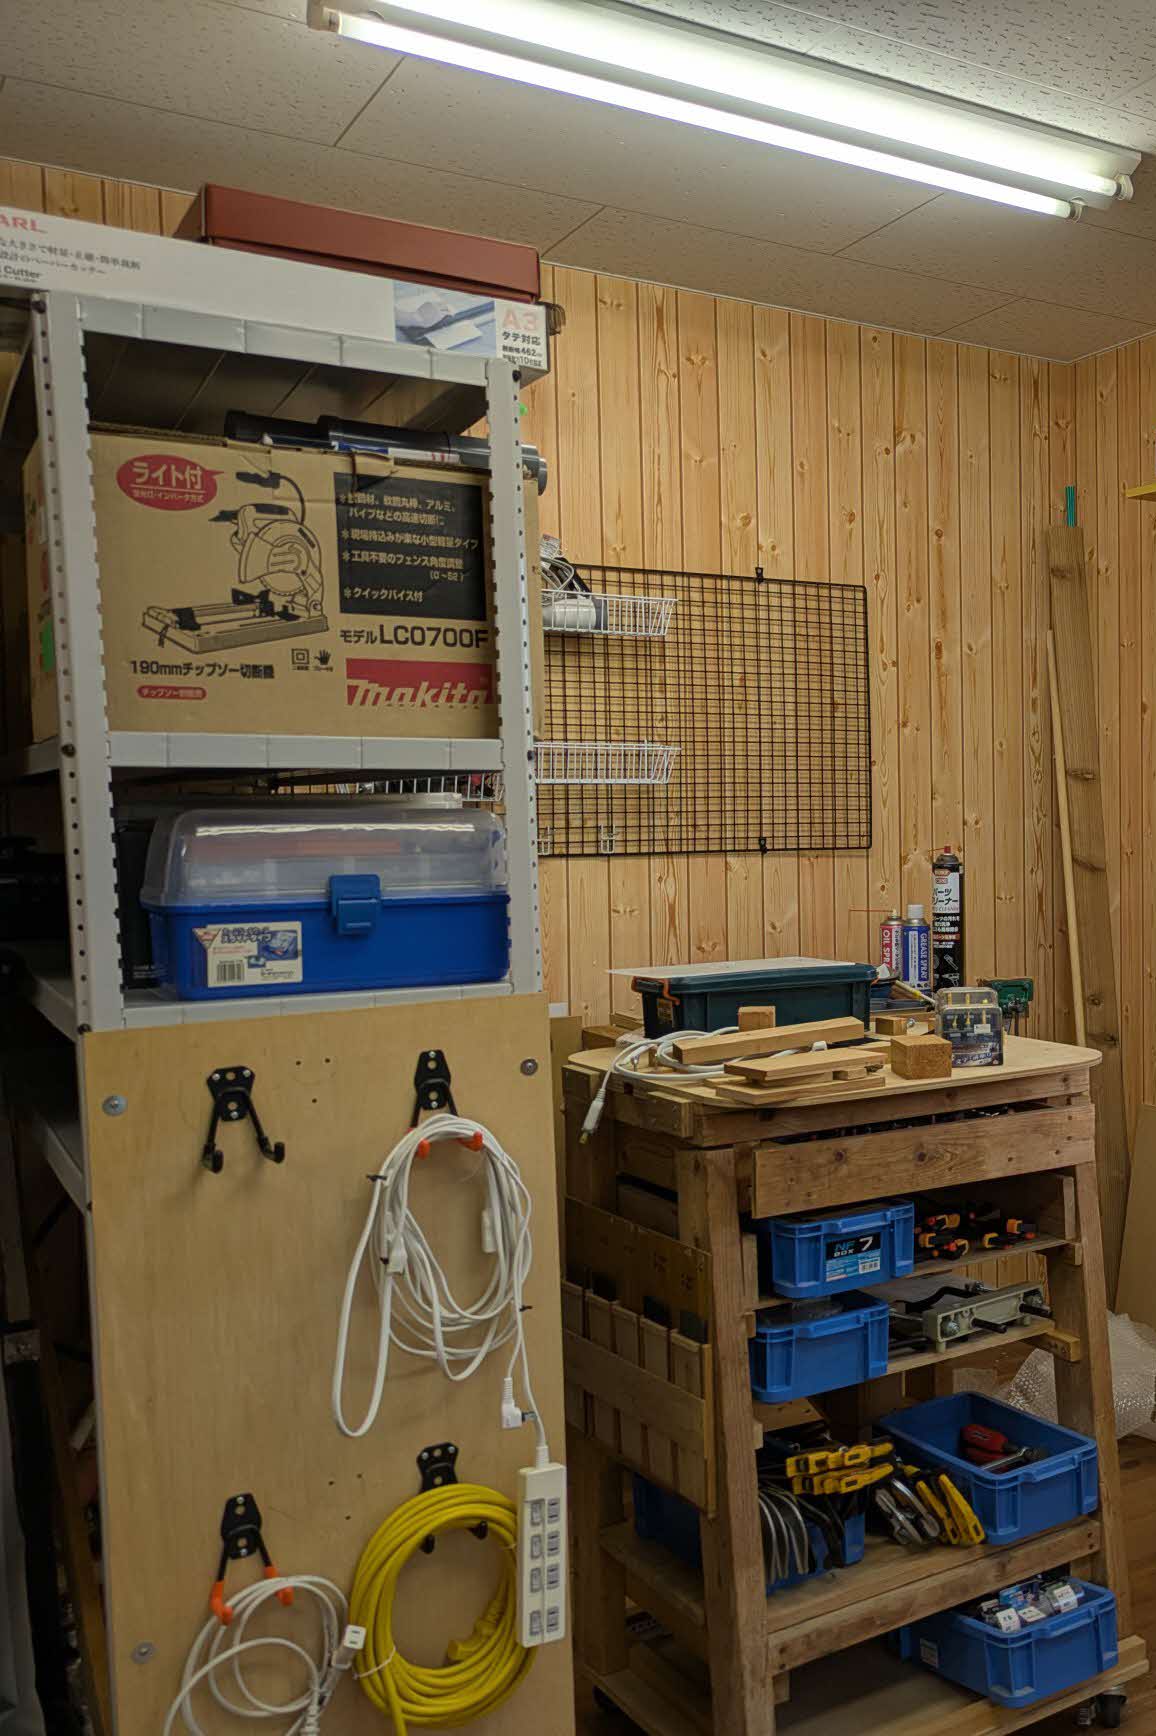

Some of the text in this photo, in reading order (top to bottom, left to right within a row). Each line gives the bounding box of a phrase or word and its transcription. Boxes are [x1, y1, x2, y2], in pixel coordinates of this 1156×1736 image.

[4, 264, 42, 279] Cutter
[503, 307, 537, 331] A3
[502, 331, 541, 346] タテ対応
[132, 461, 203, 490] ライト付
[353, 587, 424, 602] クイックバイス付
[882, 929, 890, 944] OIL
[920, 932, 928, 979] GREASE SPRAY
[859, 1236, 873, 1251] 7
[834, 1249, 854, 1257] BOX
